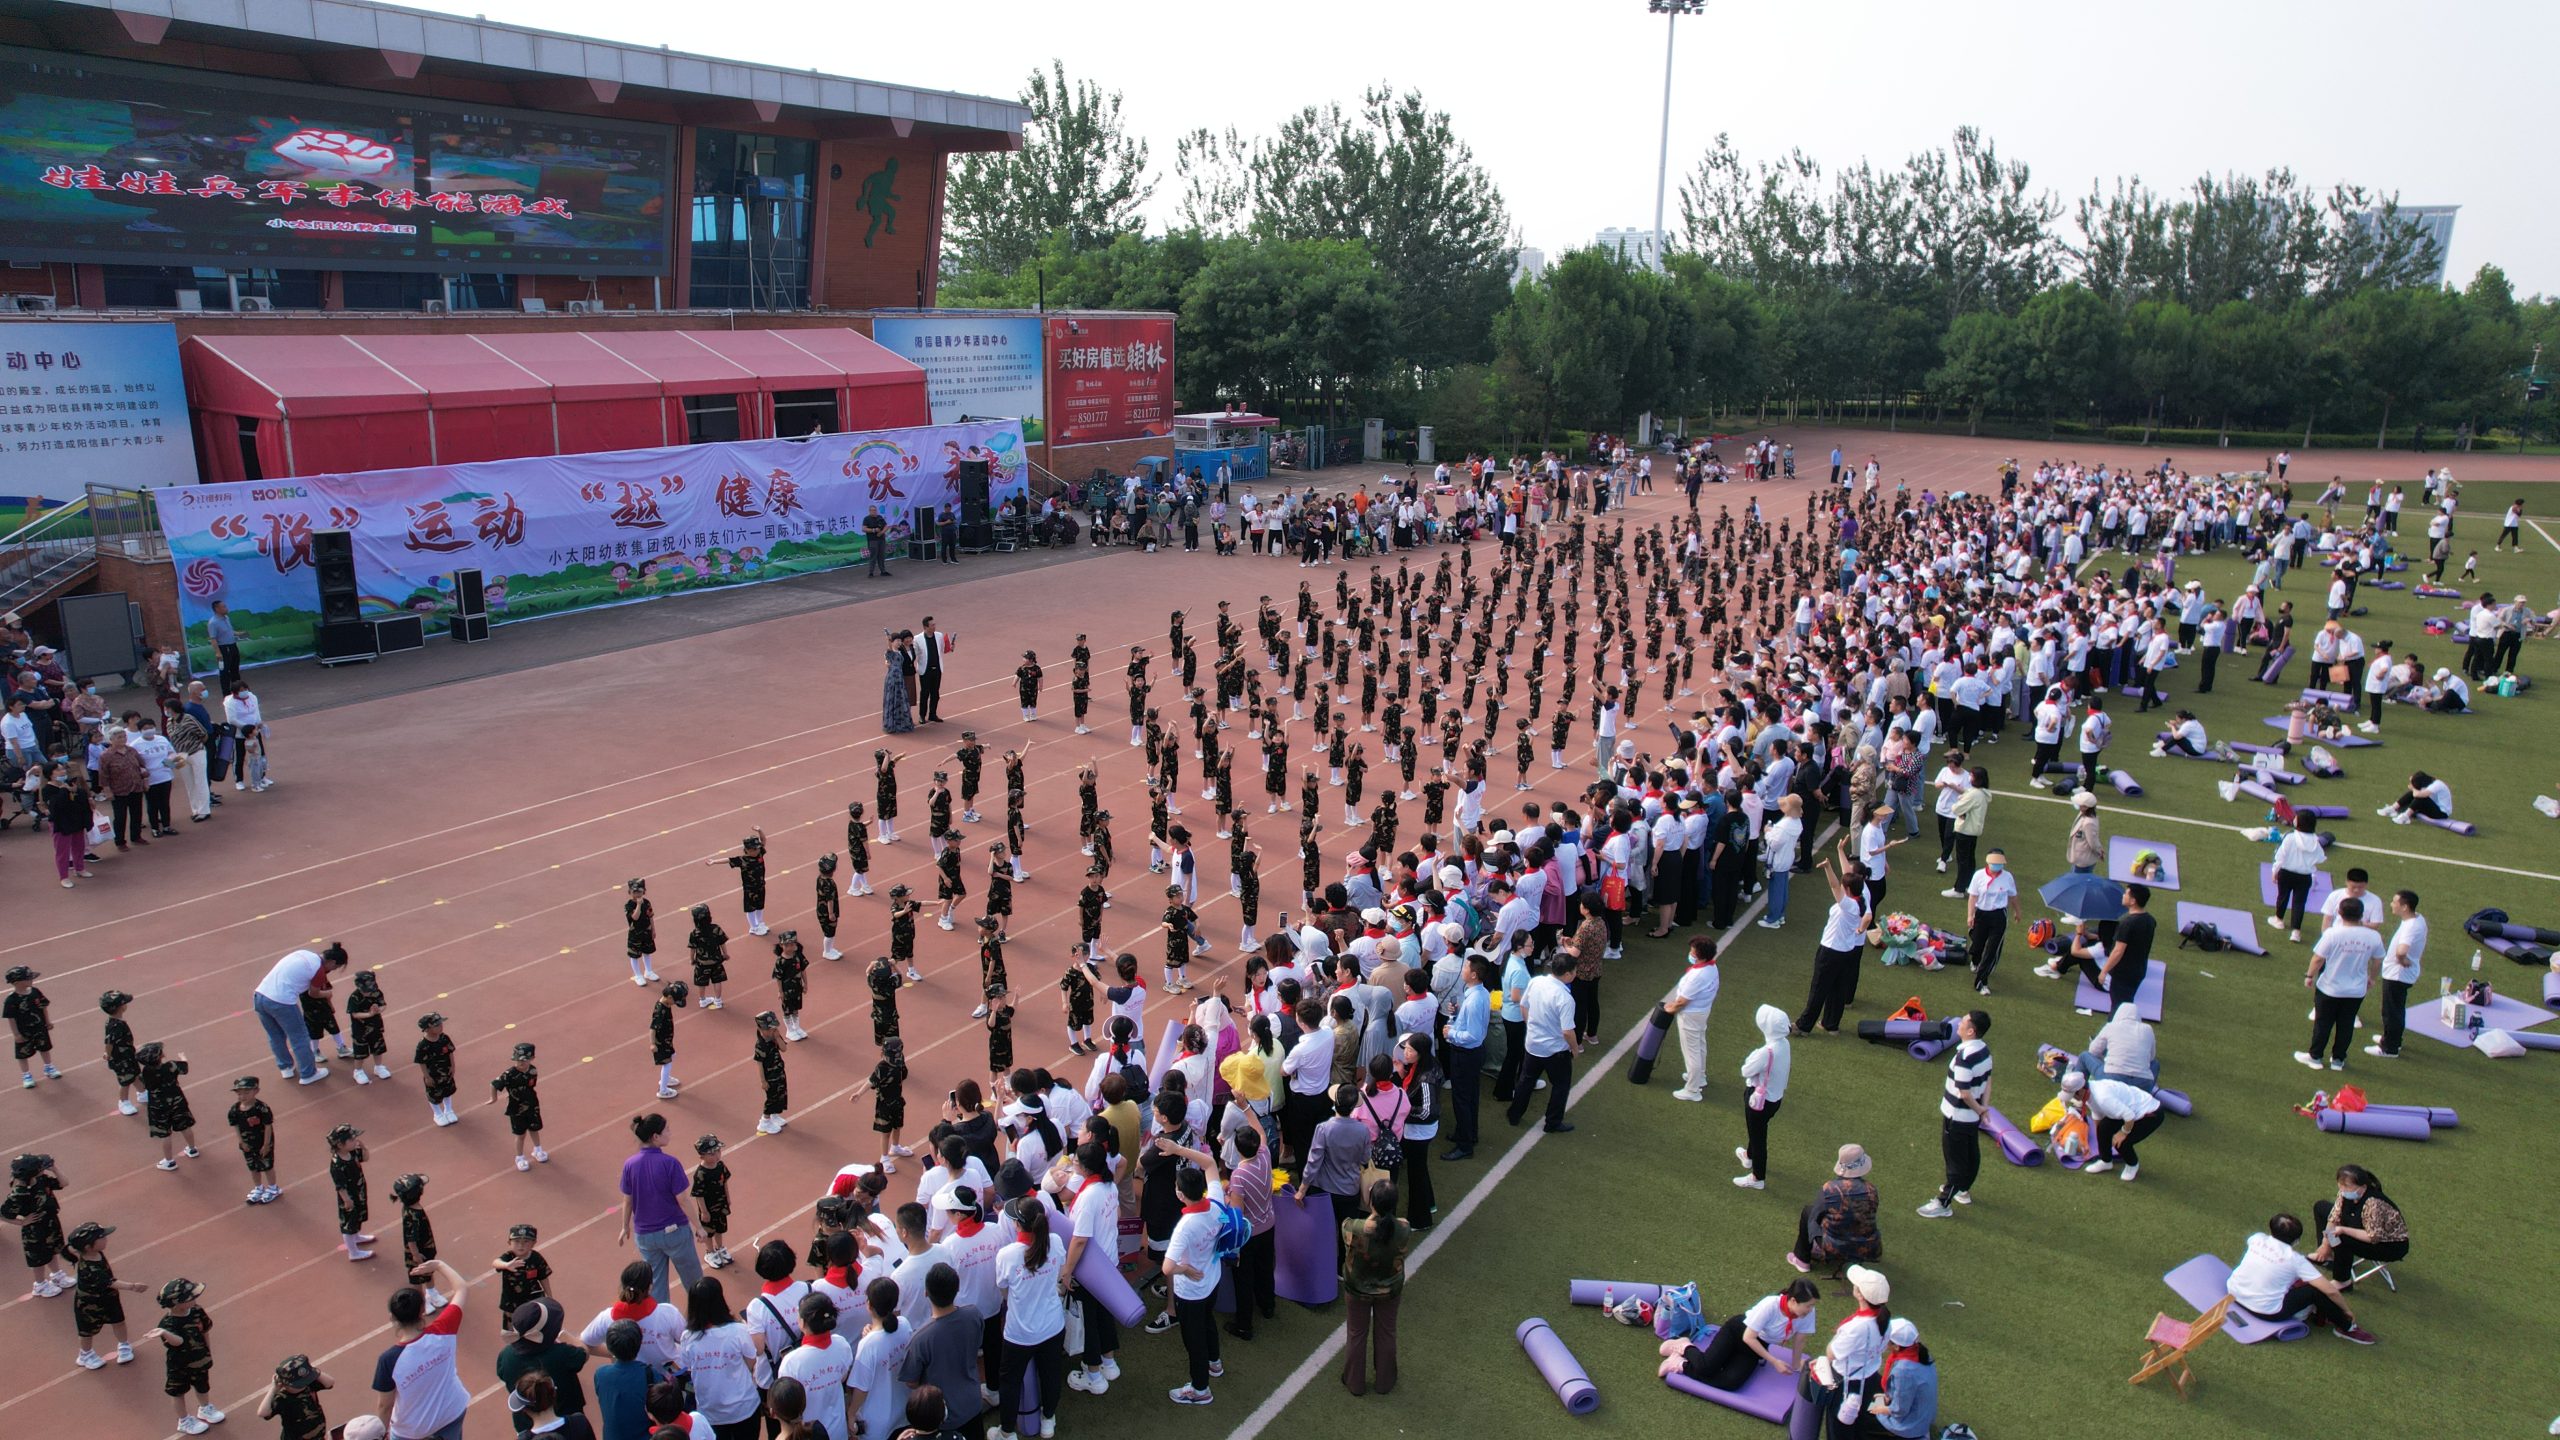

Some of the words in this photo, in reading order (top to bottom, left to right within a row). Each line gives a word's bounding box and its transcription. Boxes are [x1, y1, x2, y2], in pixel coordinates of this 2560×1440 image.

[40, 164, 572, 219] 娃娃兵军事体能游戏
[914, 335, 1008, 348] 阳信县青少年活动中心
[7, 351, 81, 370] 动中心
[405, 493, 525, 552] 运动
[716, 468, 803, 518] 健康
